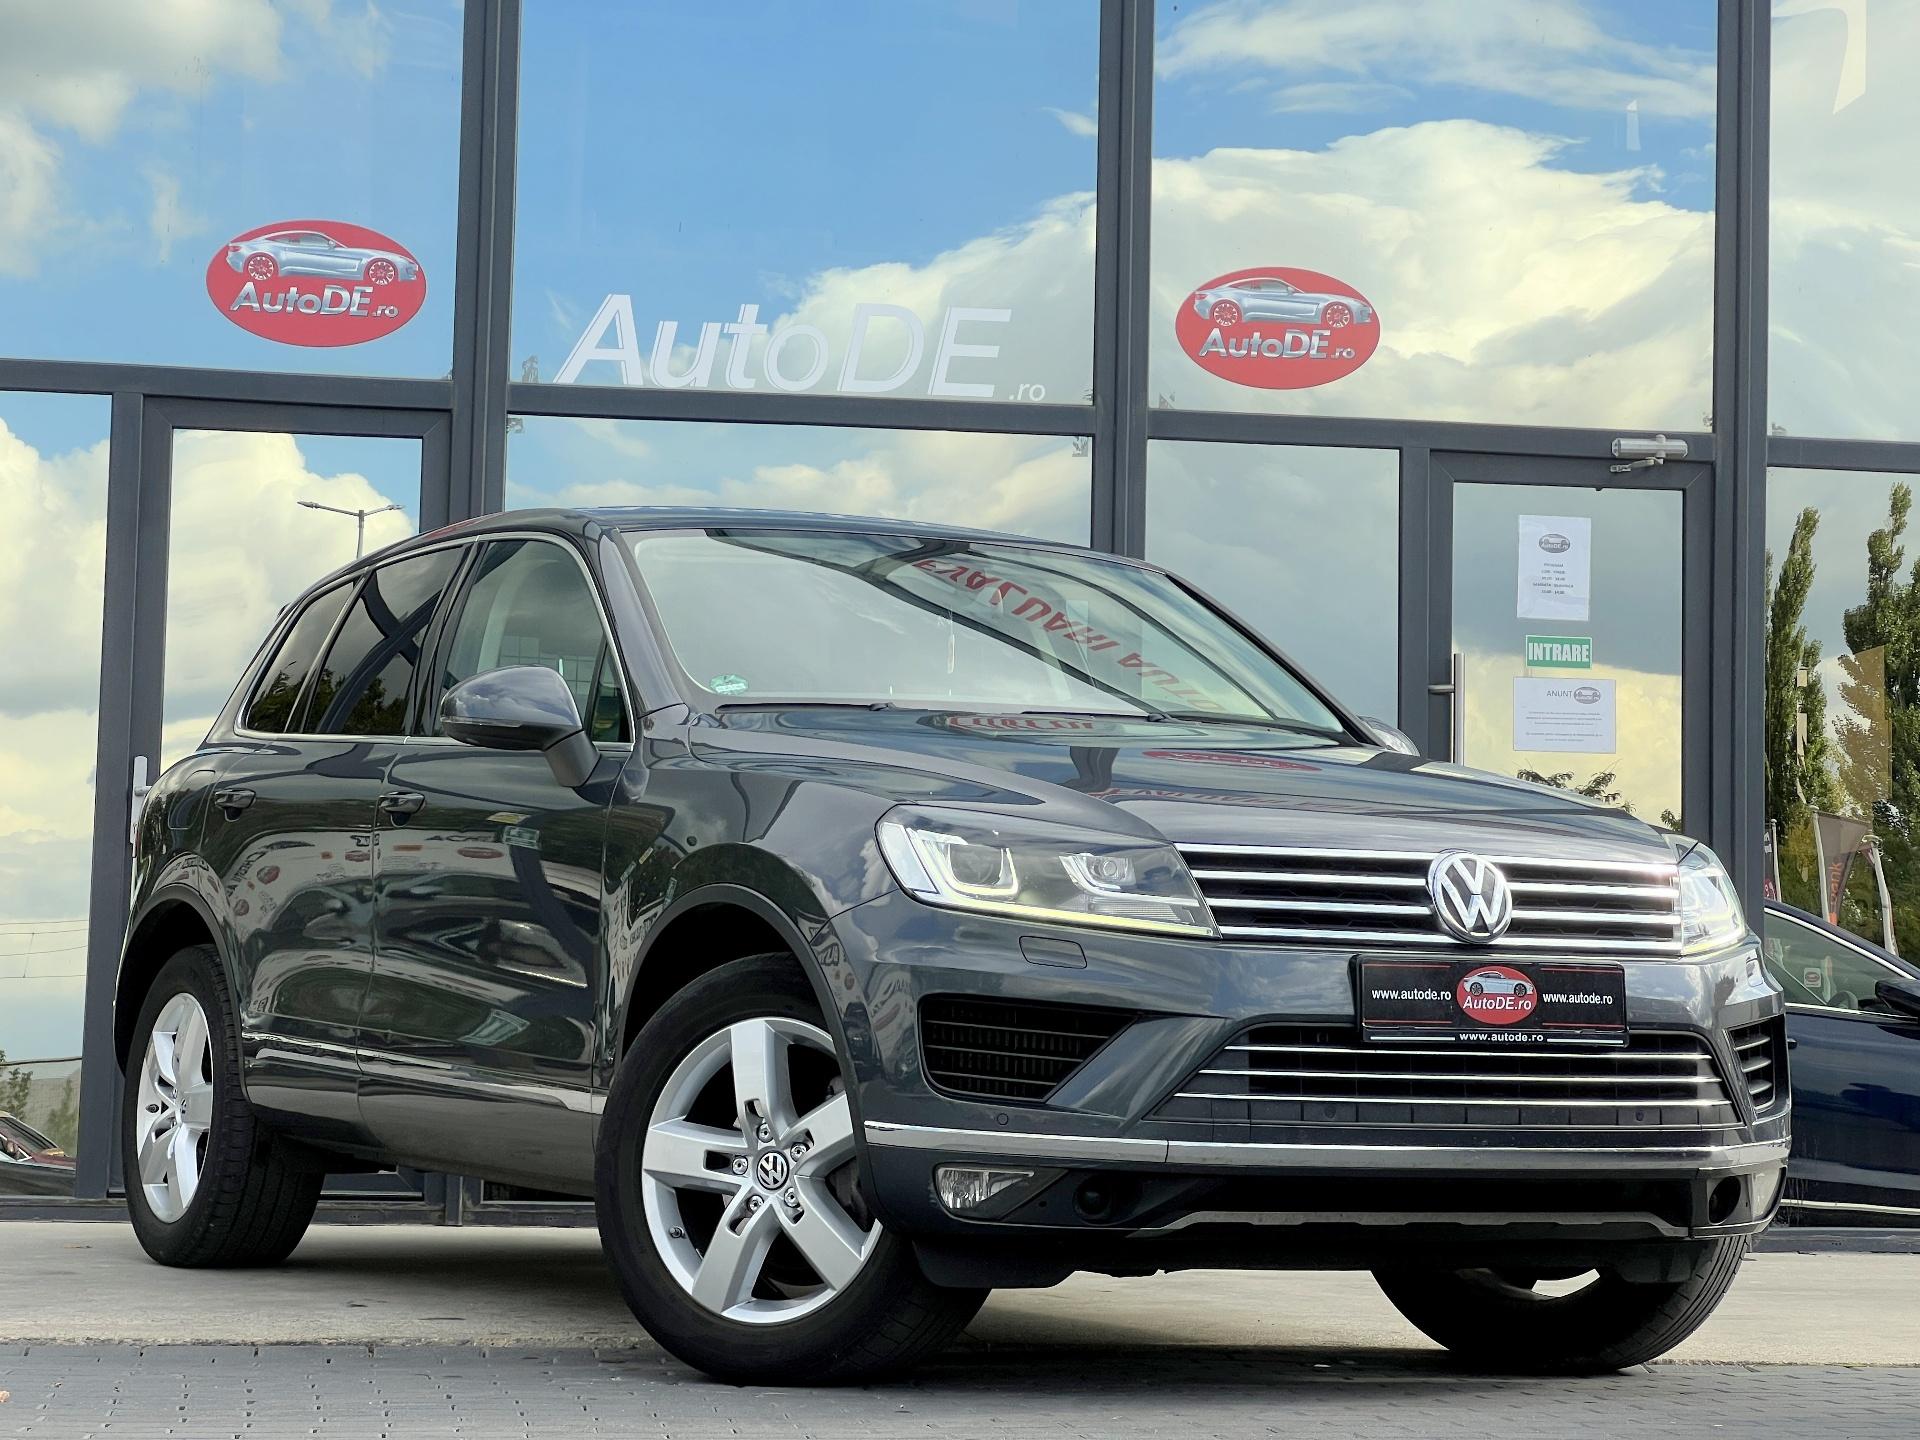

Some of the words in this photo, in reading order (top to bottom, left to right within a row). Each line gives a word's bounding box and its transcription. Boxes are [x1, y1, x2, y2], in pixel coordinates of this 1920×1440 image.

[229, 281, 399, 318] AutoDE.ro
[1199, 327, 1356, 360] AutoDE.ro
[1528, 642, 1590, 662] INTRARE
[1371, 987, 1452, 1001] www.autode.ro
[1542, 991, 1613, 1005] www.autode.ro
[1462, 995, 1532, 1011] AutoDE.ro
[1458, 1032, 1544, 1043] www.autode.ro
